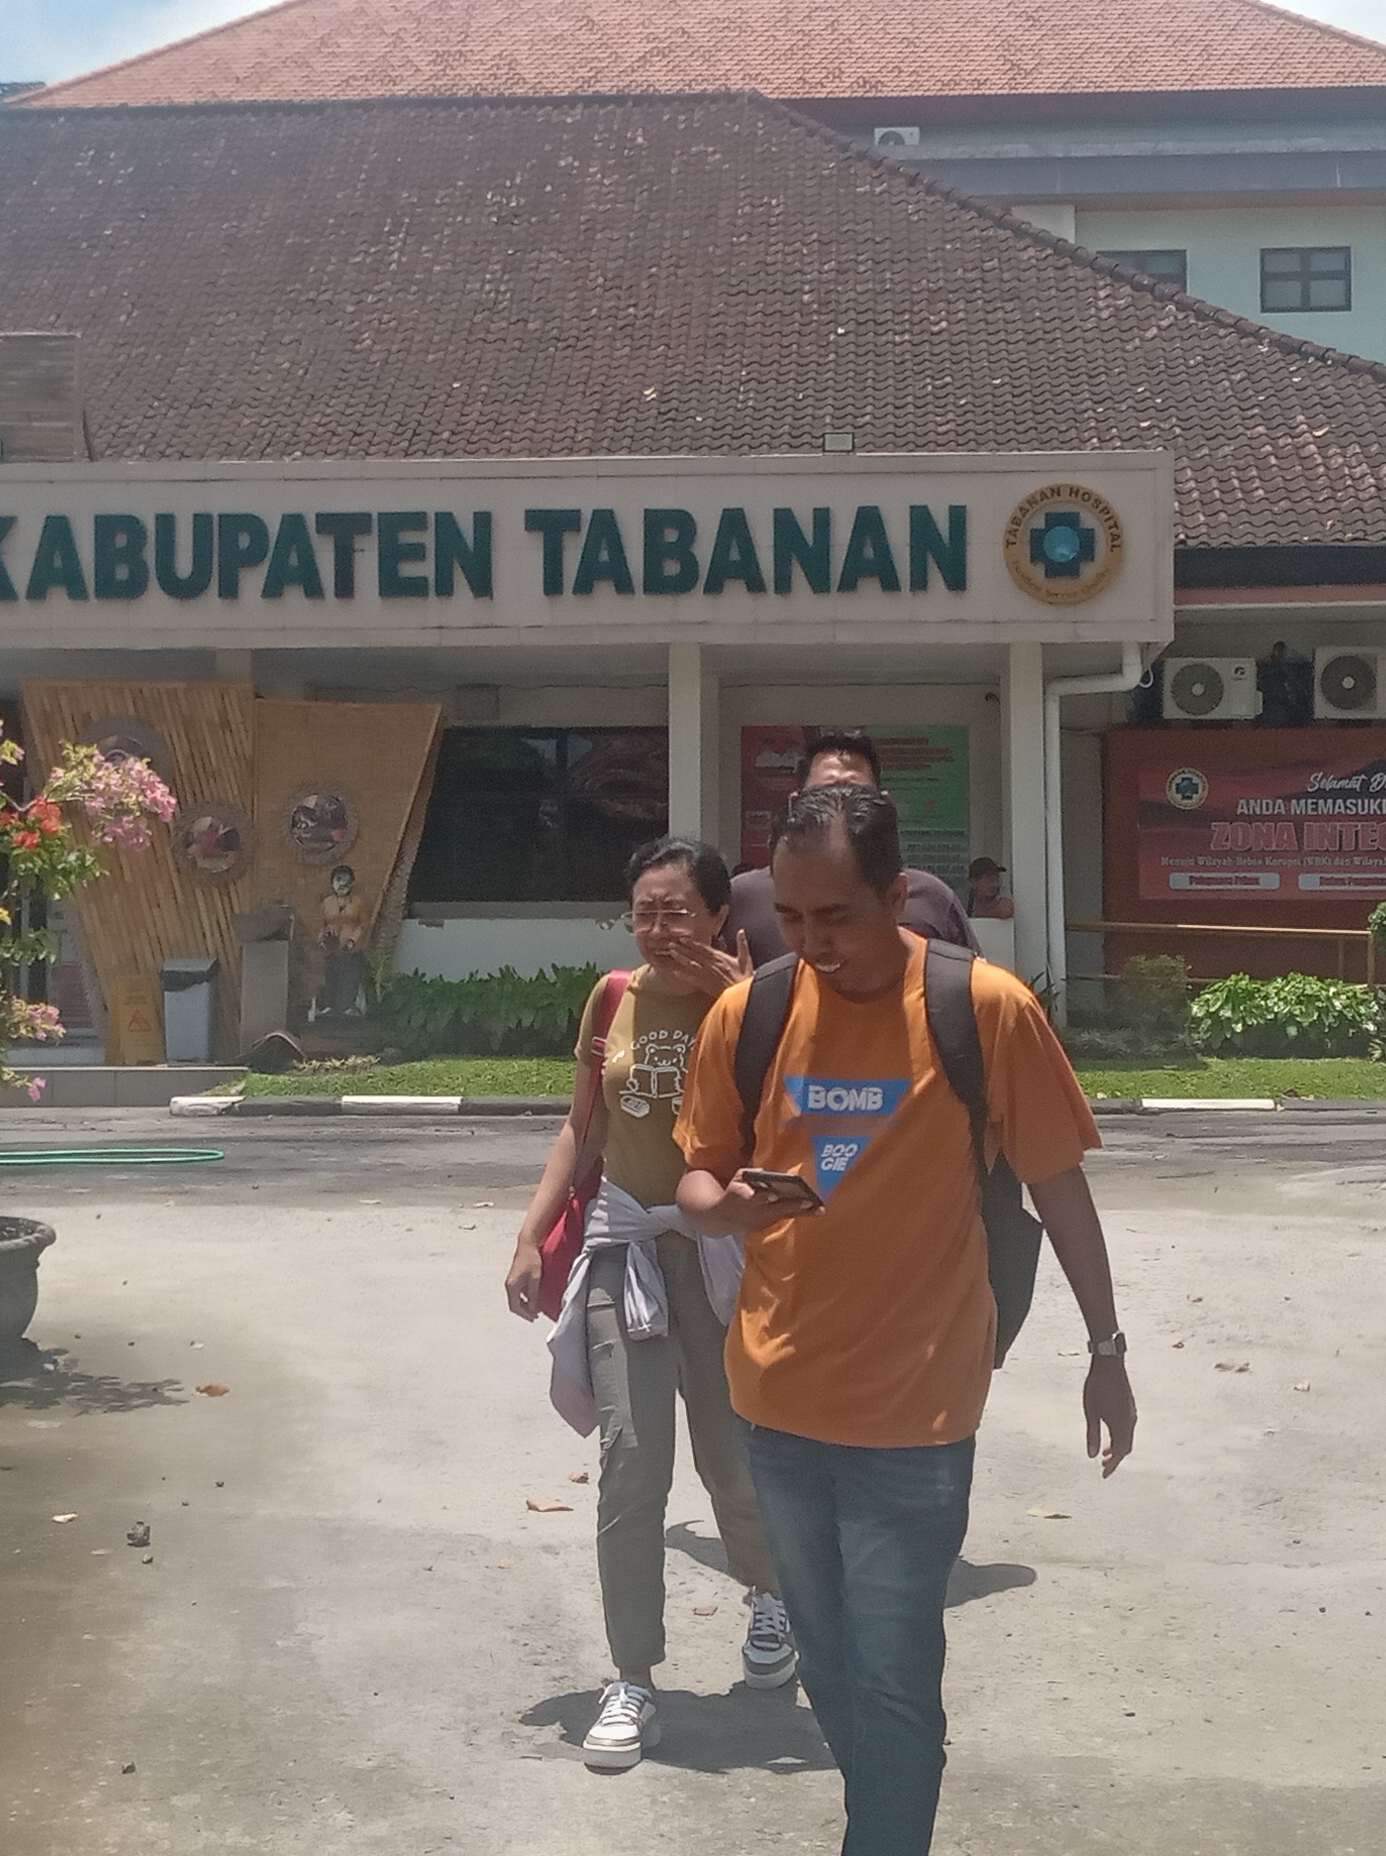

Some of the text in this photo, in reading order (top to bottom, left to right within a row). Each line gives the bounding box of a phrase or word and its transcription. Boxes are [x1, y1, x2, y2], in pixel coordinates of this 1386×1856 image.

[1006, 486, 1122, 552] TABANAN HOSPITAL
[524, 504, 968, 597] TABANAN
[1307, 772, 1368, 793] Selamat
[1237, 799, 1286, 816] ANDA
[1290, 799, 1386, 816] MEMASUKI
[1211, 821, 1299, 852] ZONA
[1333, 856, 1351, 866] dan
[630, 1030, 668, 1050] GOOD
[808, 1085, 884, 1111] BOMB
[821, 1143, 858, 1158] BOO
[821, 1157, 849, 1171] GIE
